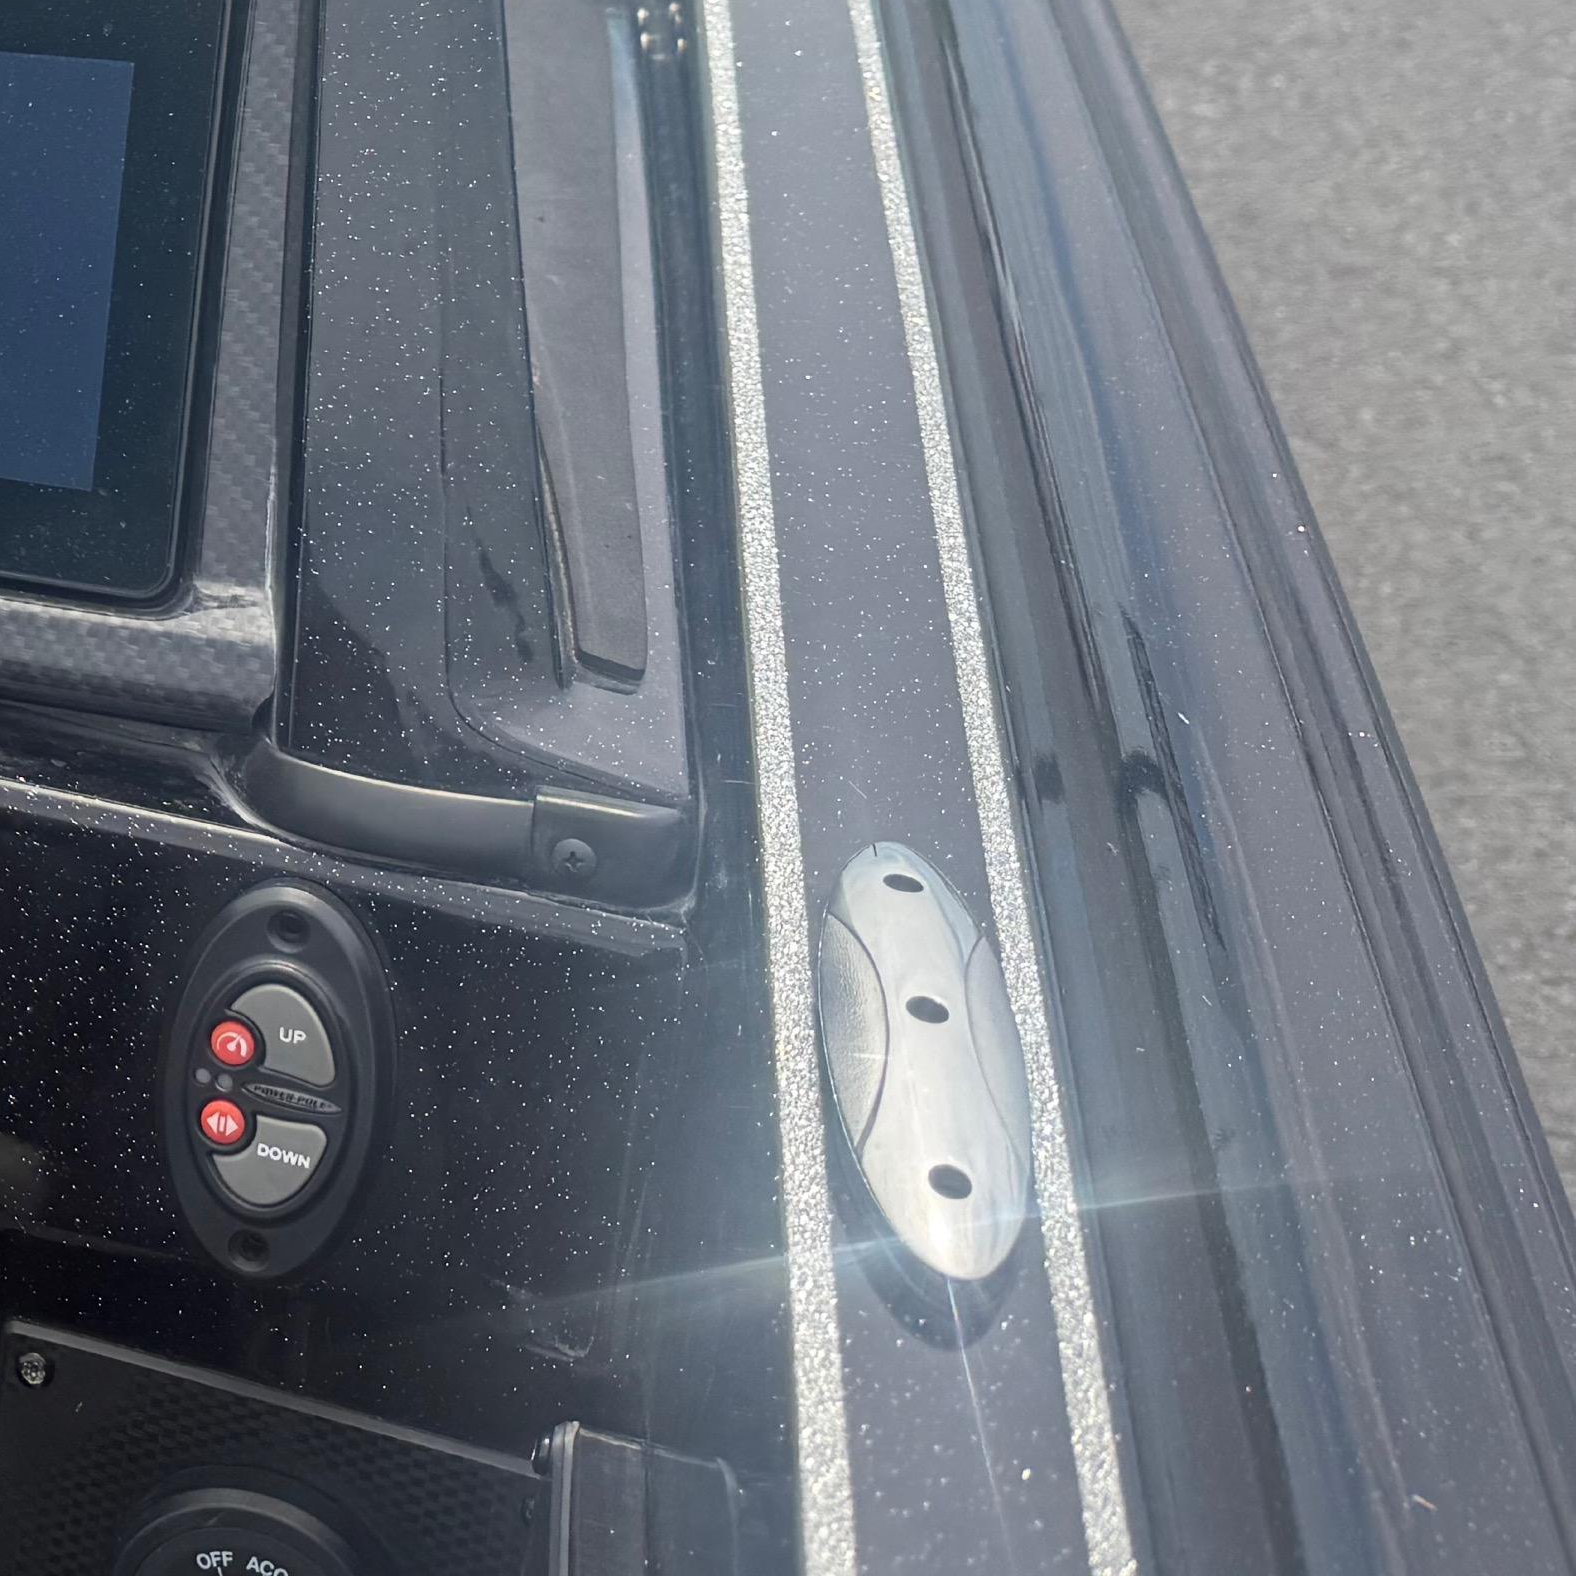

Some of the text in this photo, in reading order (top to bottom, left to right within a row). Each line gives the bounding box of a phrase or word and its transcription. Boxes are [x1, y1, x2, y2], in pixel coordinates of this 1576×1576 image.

[279, 1026, 306, 1044] UP
[257, 1143, 311, 1169] DOWN
[196, 1550, 233, 1570] OFF
